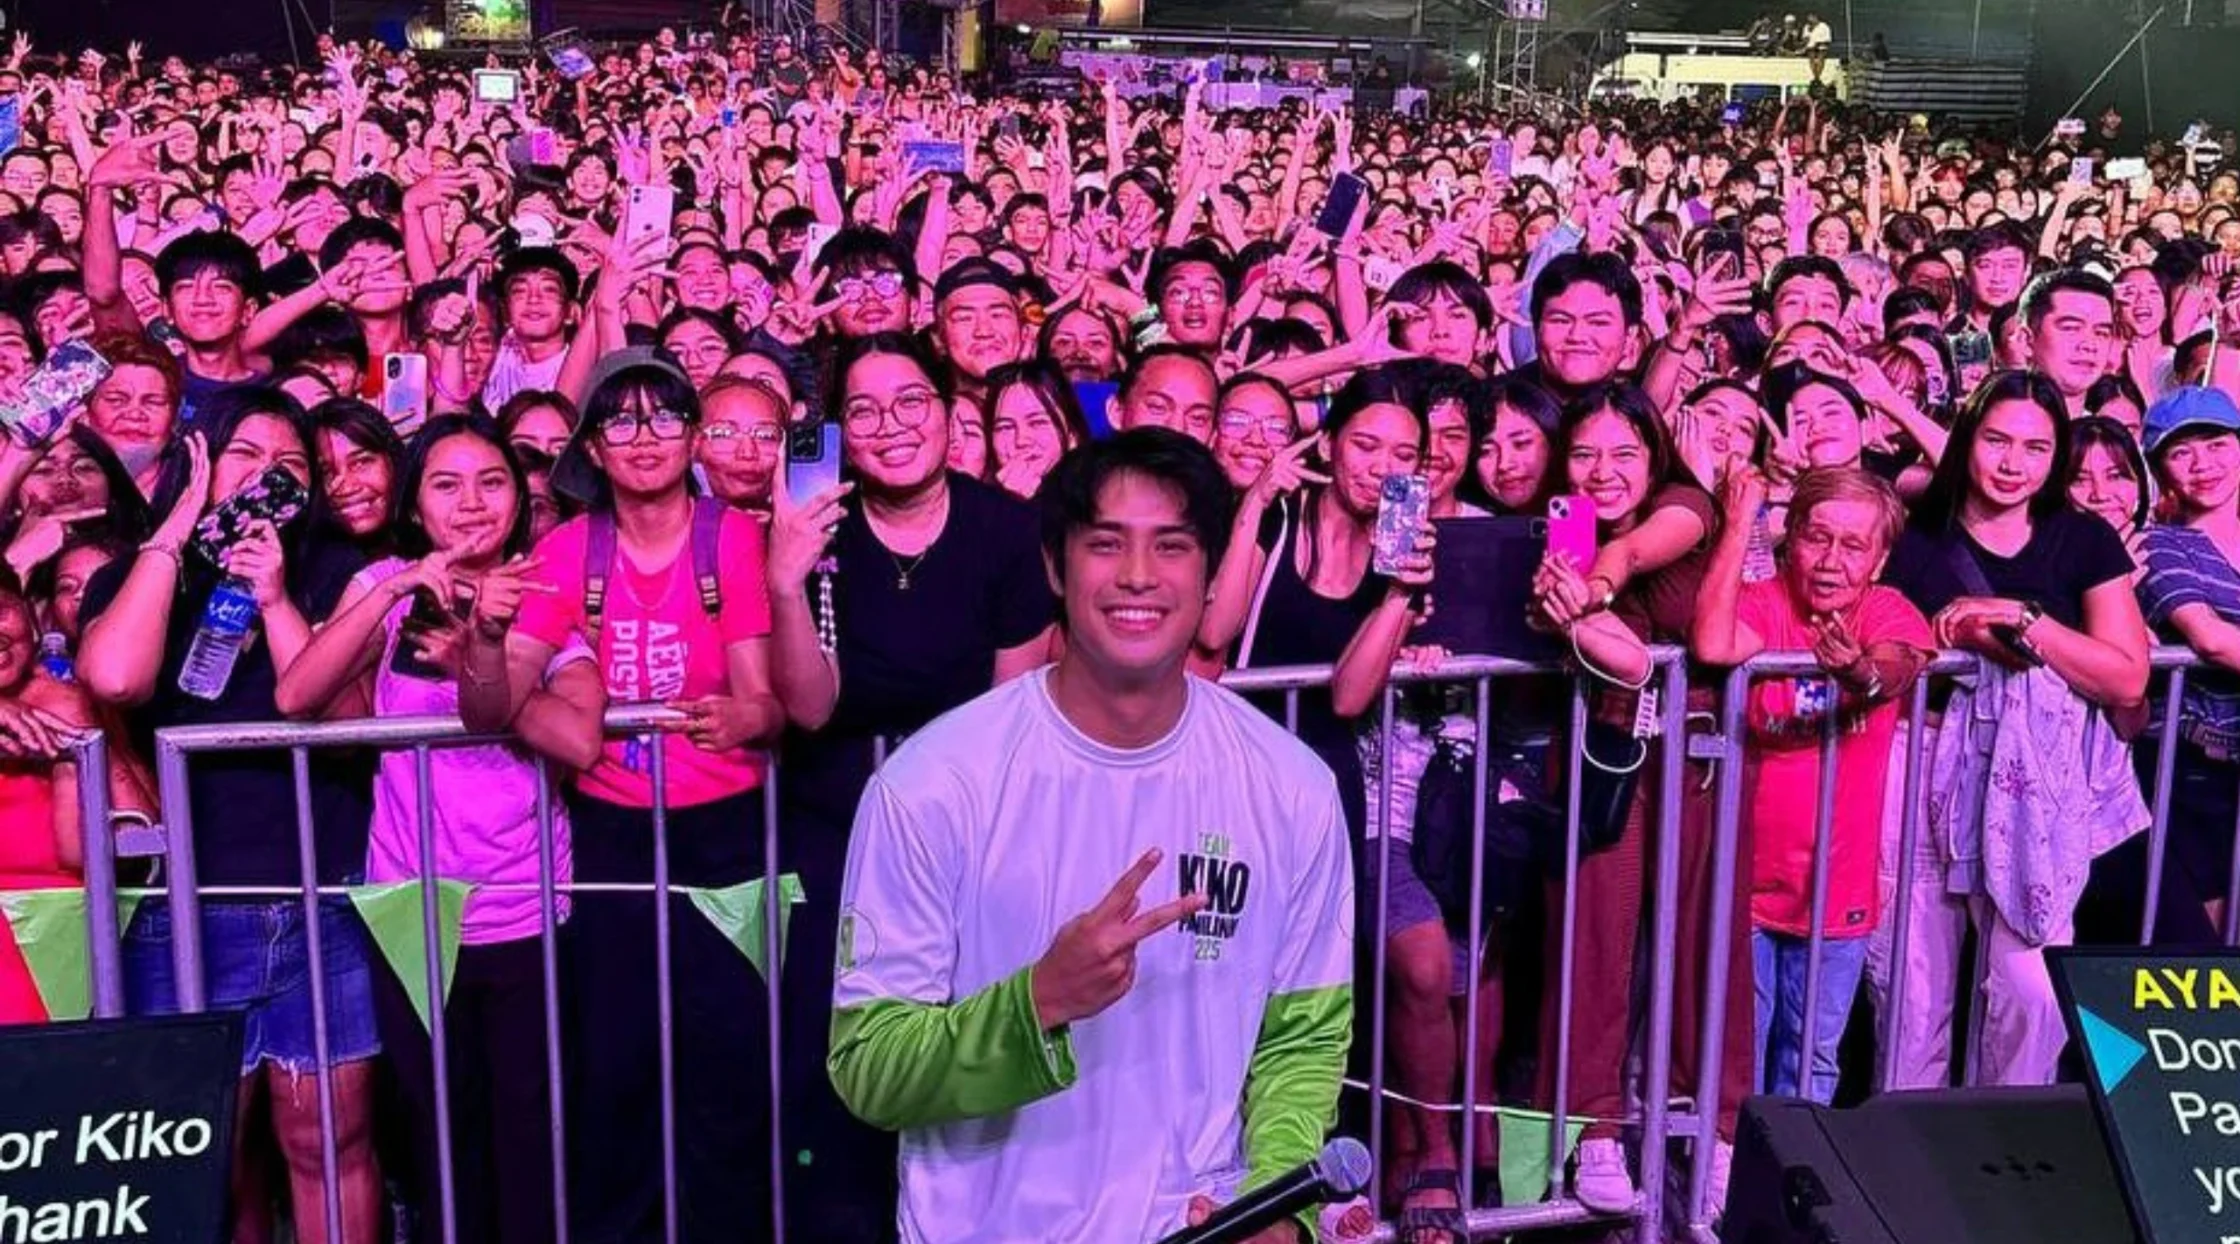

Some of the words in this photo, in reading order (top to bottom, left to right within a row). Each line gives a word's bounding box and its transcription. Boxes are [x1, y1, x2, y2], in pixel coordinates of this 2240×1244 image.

[1179, 854, 1250, 914] KIKO
[2135, 968, 2240, 1009] AYA
[75, 1110, 212, 1165] Kiko
